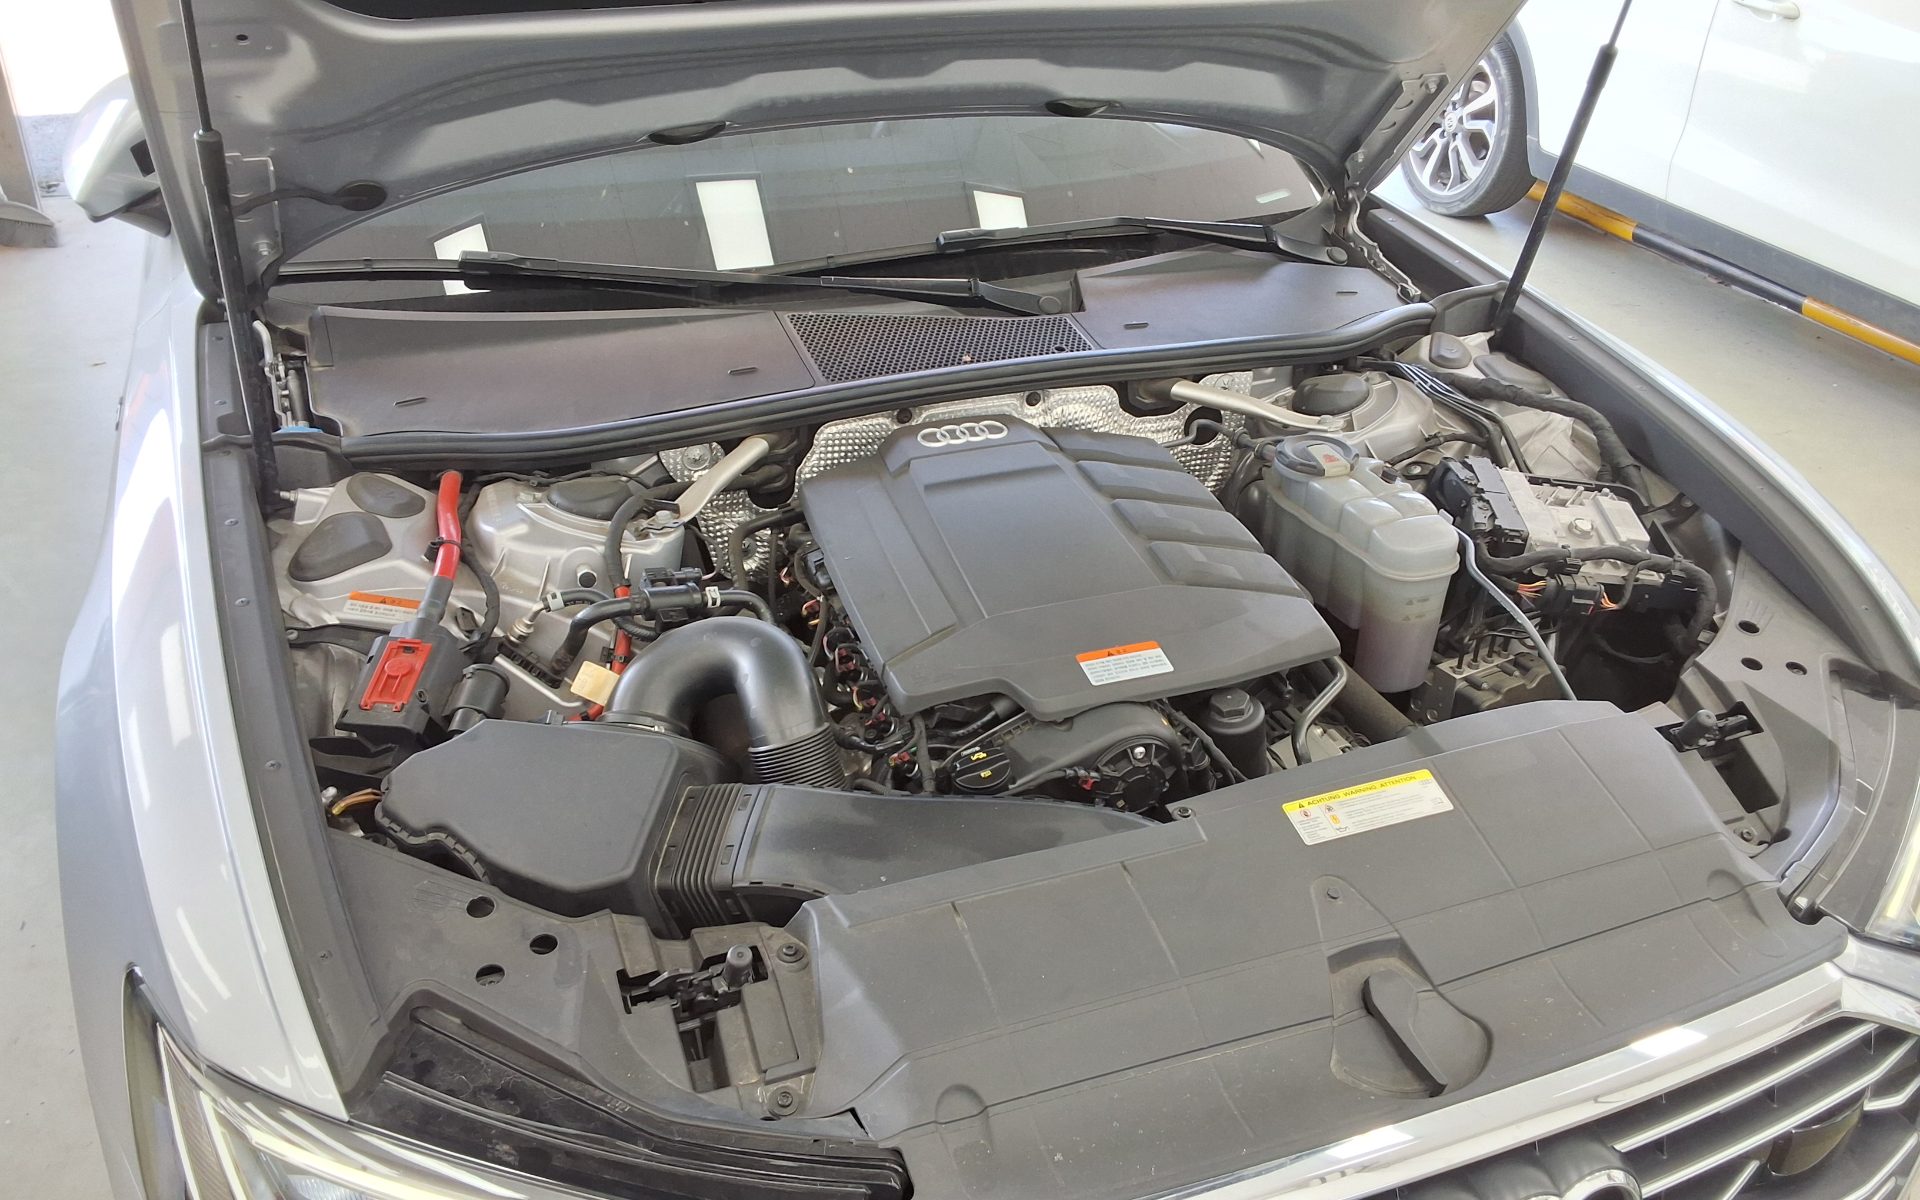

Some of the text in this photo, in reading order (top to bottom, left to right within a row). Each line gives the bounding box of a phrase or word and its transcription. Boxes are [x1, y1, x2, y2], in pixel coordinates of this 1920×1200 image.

[1307, 794, 1341, 806] ACHTUNG
[1343, 785, 1377, 797] WARNING
[1380, 776, 1417, 789] ATTENTION
